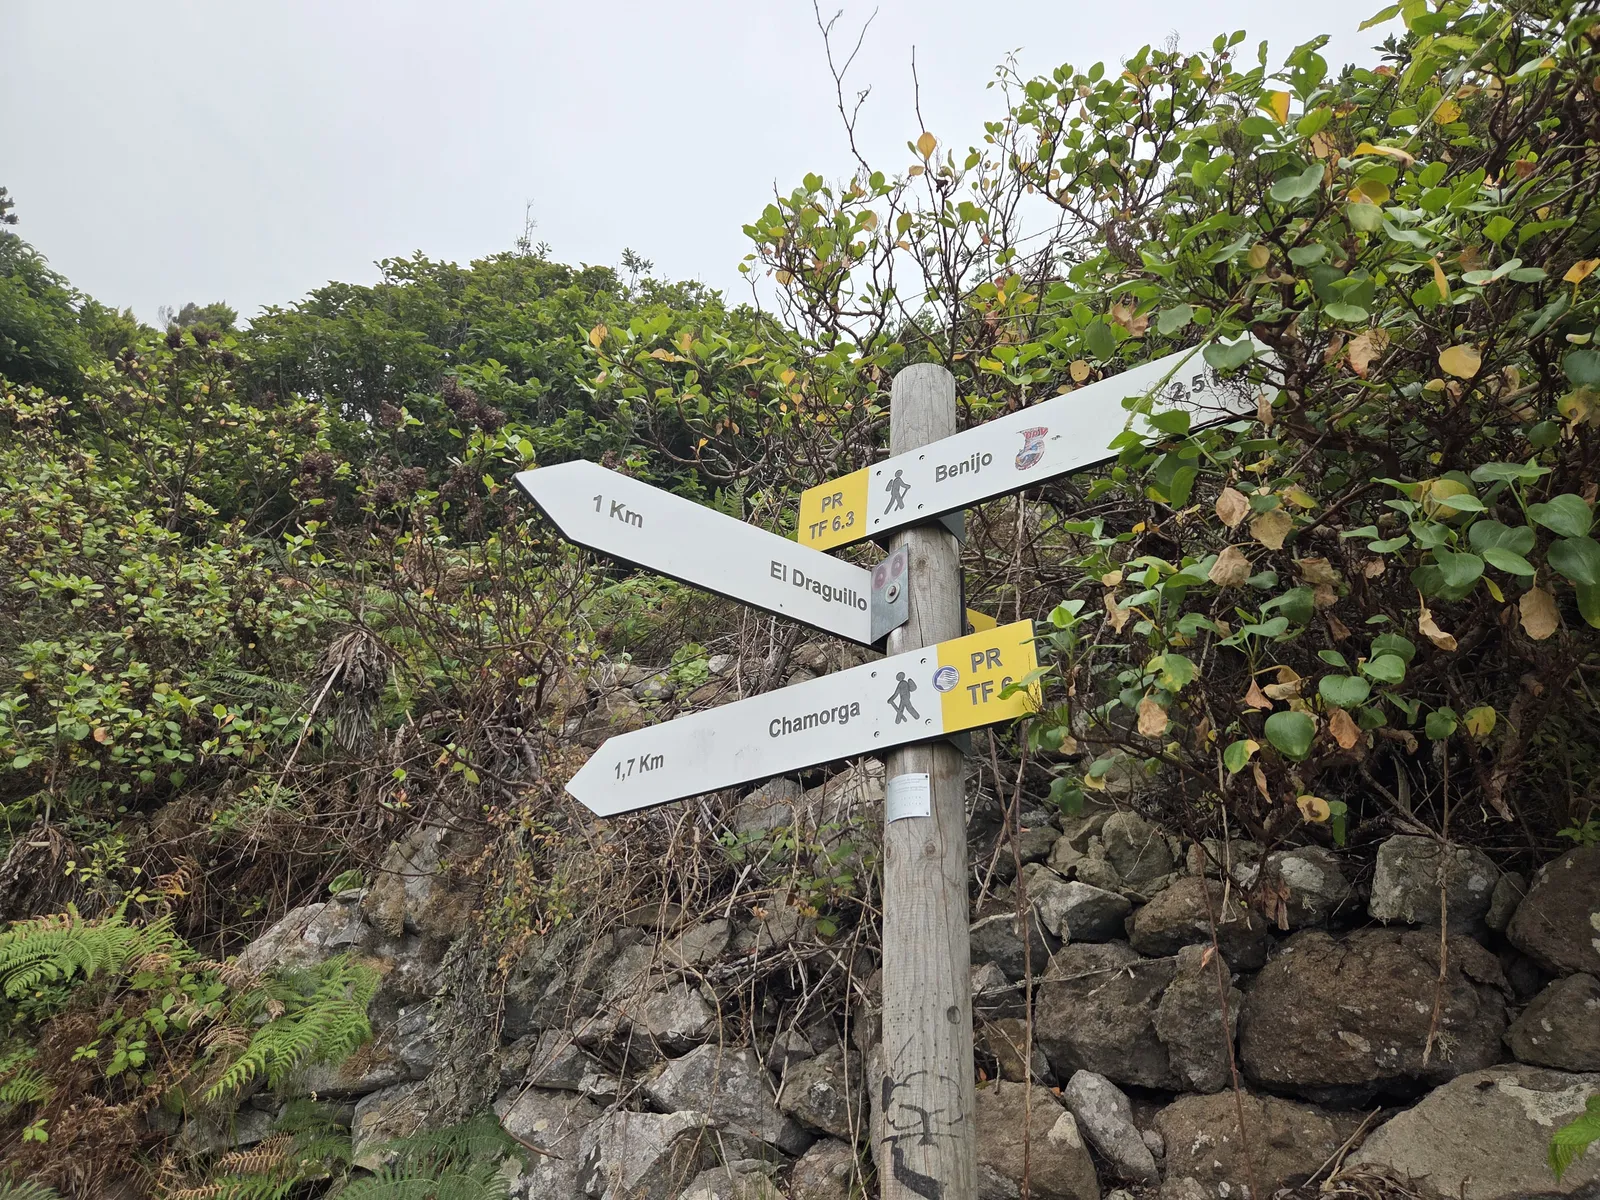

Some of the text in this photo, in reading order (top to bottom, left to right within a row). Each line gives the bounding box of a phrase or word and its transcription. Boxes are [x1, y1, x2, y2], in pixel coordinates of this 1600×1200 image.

[1170, 373, 1206, 401] 2,5
[935, 451, 993, 483] Benijo
[593, 494, 643, 529] 1 Km
[821, 491, 844, 513] PR
[808, 510, 855, 540] TF 6.3
[770, 560, 868, 611] El Draguillo
[970, 647, 1003, 673] PR
[966, 680, 994, 706] TF
[768, 701, 861, 738] Chamorga
[614, 752, 664, 782] 1,7 Km
